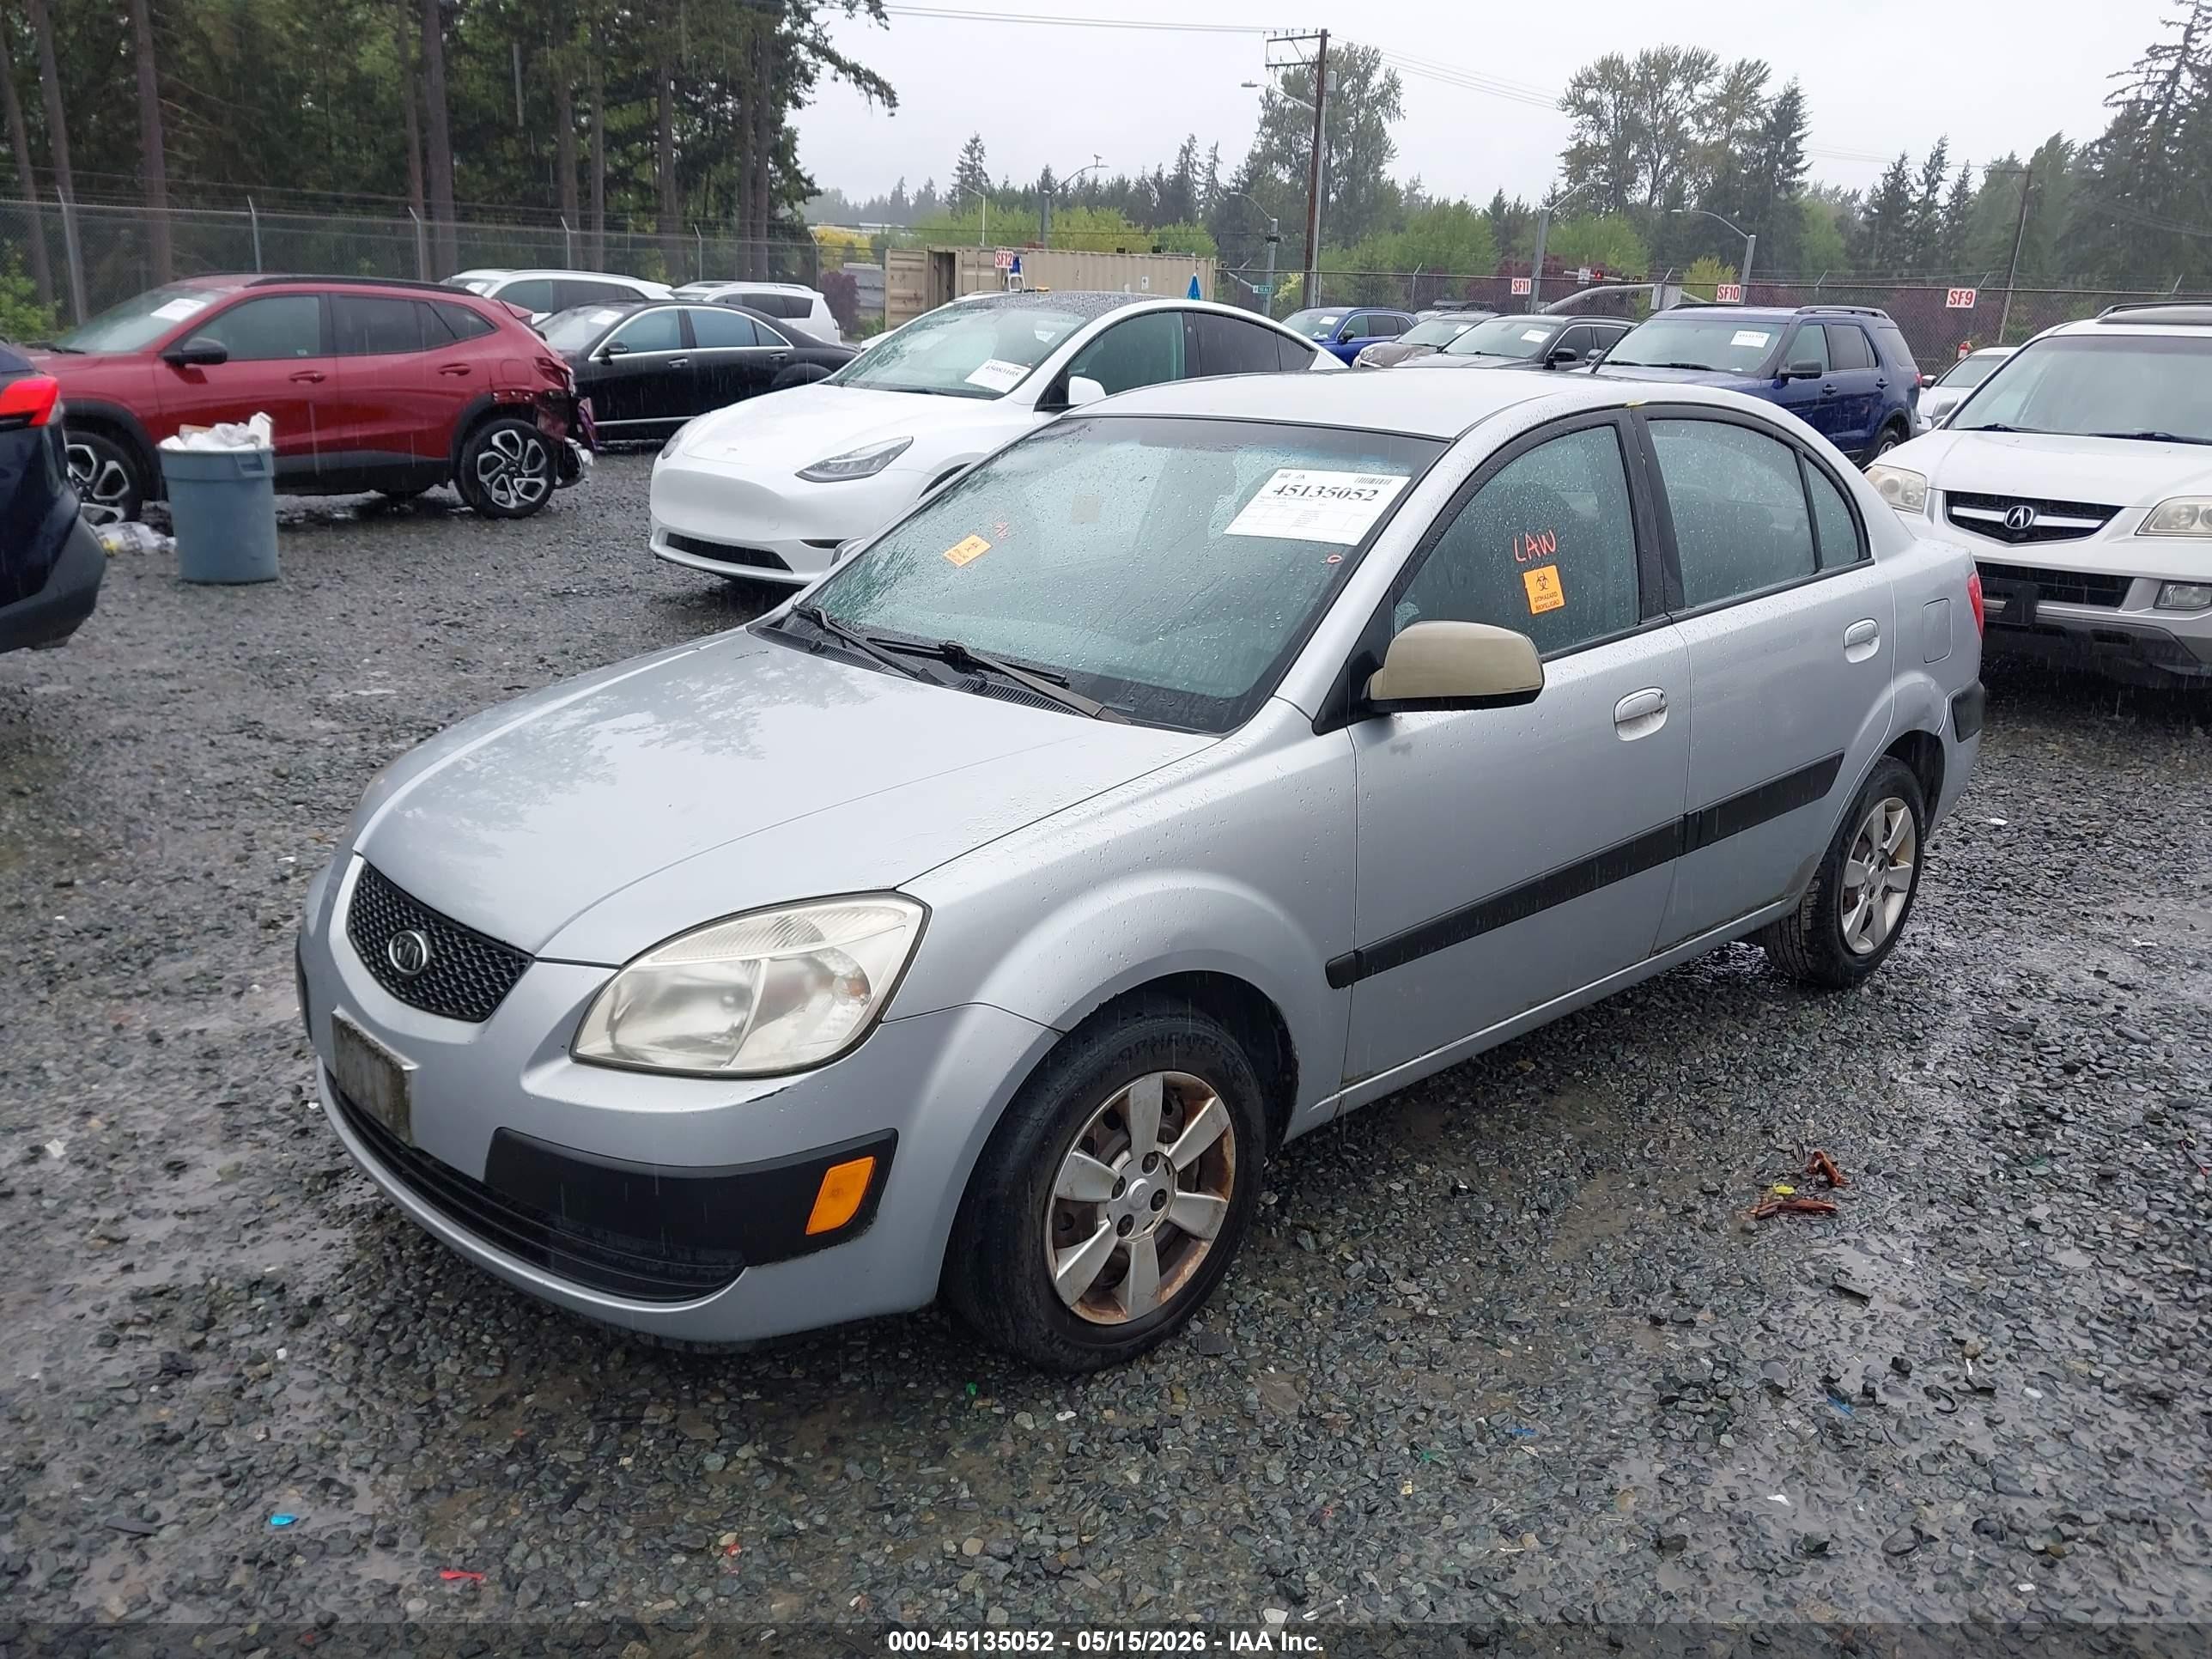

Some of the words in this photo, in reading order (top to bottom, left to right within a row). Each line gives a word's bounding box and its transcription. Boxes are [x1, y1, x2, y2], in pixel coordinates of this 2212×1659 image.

[996, 252, 1012, 266] SF12
[1513, 280, 1529, 292] SF11
[1717, 286, 1740, 301] SF10
[1949, 290, 1973, 306] SF9
[1273, 483, 1379, 501] 45135052
[1514, 530, 1556, 562] LAW
